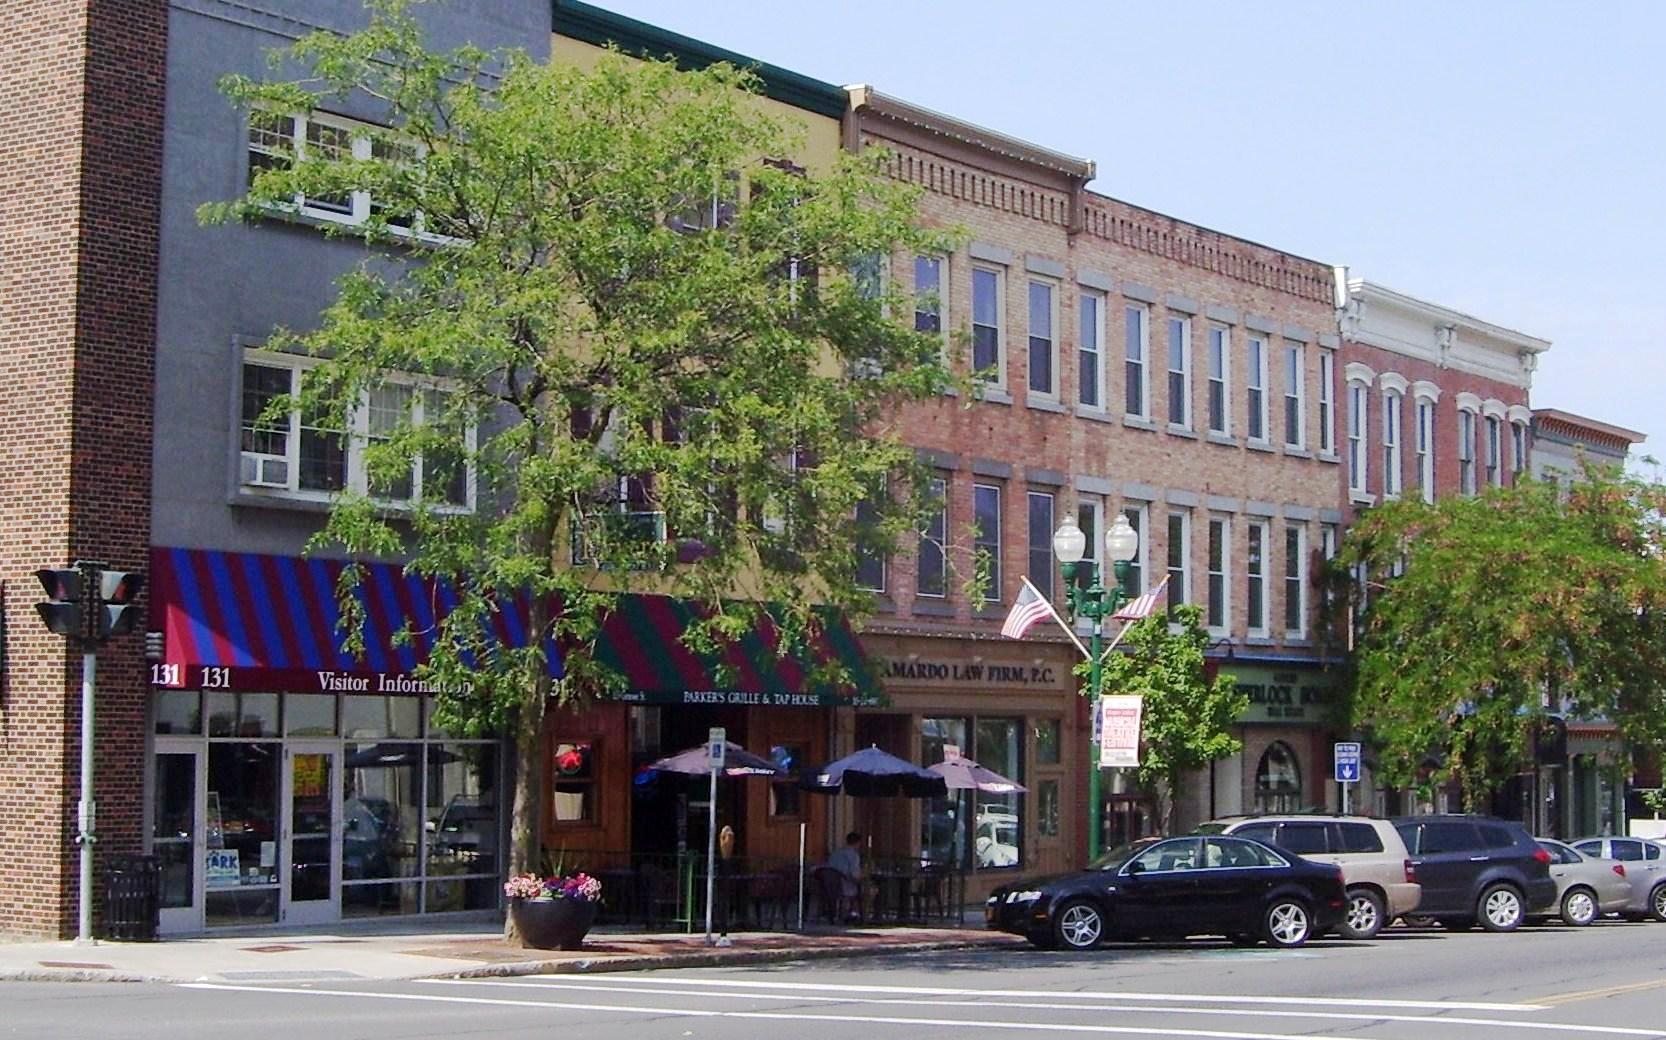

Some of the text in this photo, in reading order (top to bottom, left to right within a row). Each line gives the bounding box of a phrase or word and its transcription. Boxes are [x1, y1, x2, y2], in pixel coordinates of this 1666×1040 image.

[151, 663, 180, 685] 131
[201, 667, 231, 688] 131
[317, 671, 473, 695] Visitor Informaton
[881, 662, 1055, 684] AMARDO LAW FIRM, P.C.
[683, 691, 820, 705] PARKER'S GRILLE & TAP HOUSE
